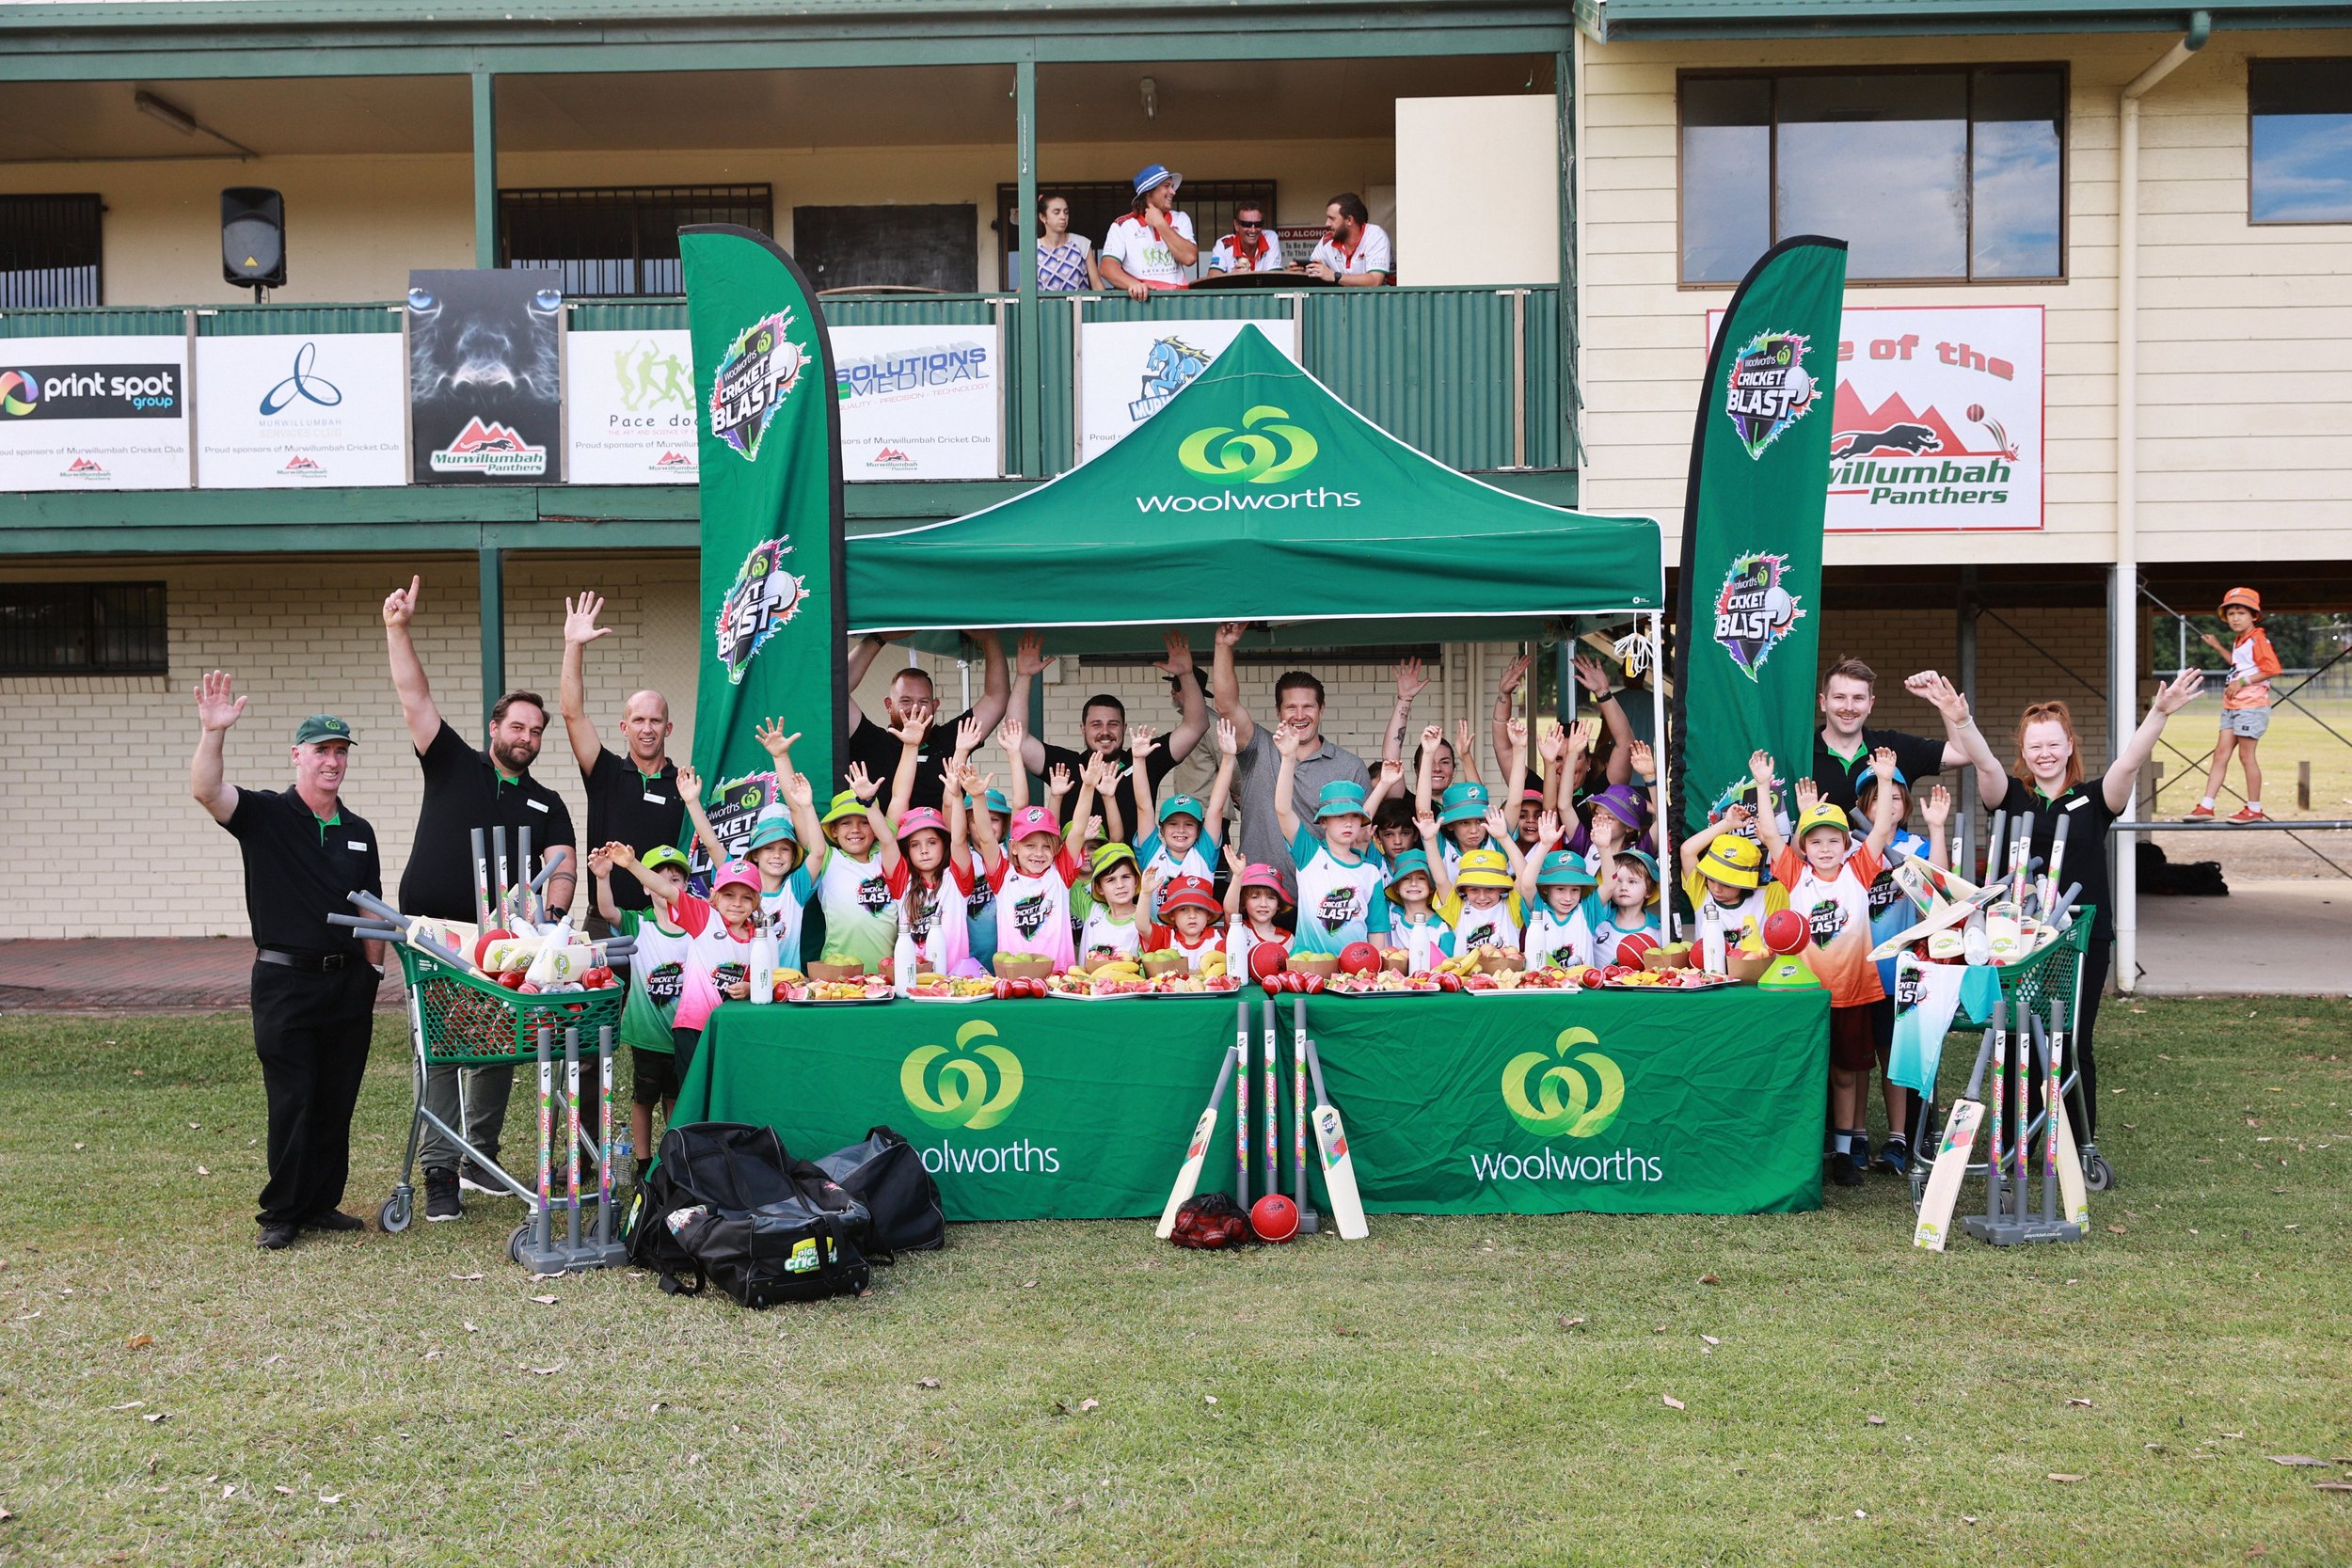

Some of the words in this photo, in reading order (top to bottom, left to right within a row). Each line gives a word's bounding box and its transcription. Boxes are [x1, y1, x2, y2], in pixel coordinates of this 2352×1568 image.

[836, 347, 986, 384] SOLUTIONS
[1869, 335, 1919, 360] of
[1935, 341, 2014, 381] the
[44, 372, 105, 402] print
[111, 372, 173, 401] spot
[720, 356, 769, 404] CRICKET
[850, 362, 990, 397] MEDICAL
[1737, 369, 1786, 387] CRICKET
[133, 397, 173, 410] group
[714, 367, 787, 432] BLAST
[880, 392, 925, 404] PRECISION
[933, 383, 990, 396] TECHNOLOGY
[1727, 388, 1798, 418] BLAST
[610, 415, 655, 427] Pace
[232, 446, 271, 454] sponsors
[434, 453, 542, 464] Murwillumbah
[1870, 487, 2009, 504] Panthers
[858, 893, 892, 903] BLAST
[1317, 908, 1356, 920] BLAST
[1810, 917, 1843, 933] LAST
[650, 975, 676, 984] CRICKET
[715, 973, 740, 983] CRICKET
[1994, 1073, 2003, 1154] playcricket.com.au
[2020, 1076, 2028, 1156] playcricket.com.au
[2049, 1074, 2059, 1155] playcricket.com.au
[541, 1105, 550, 1186] playcricket.com.au
[570, 1105, 580, 1185] playcricket.com.au
[921, 1138, 1060, 1173] olworths
